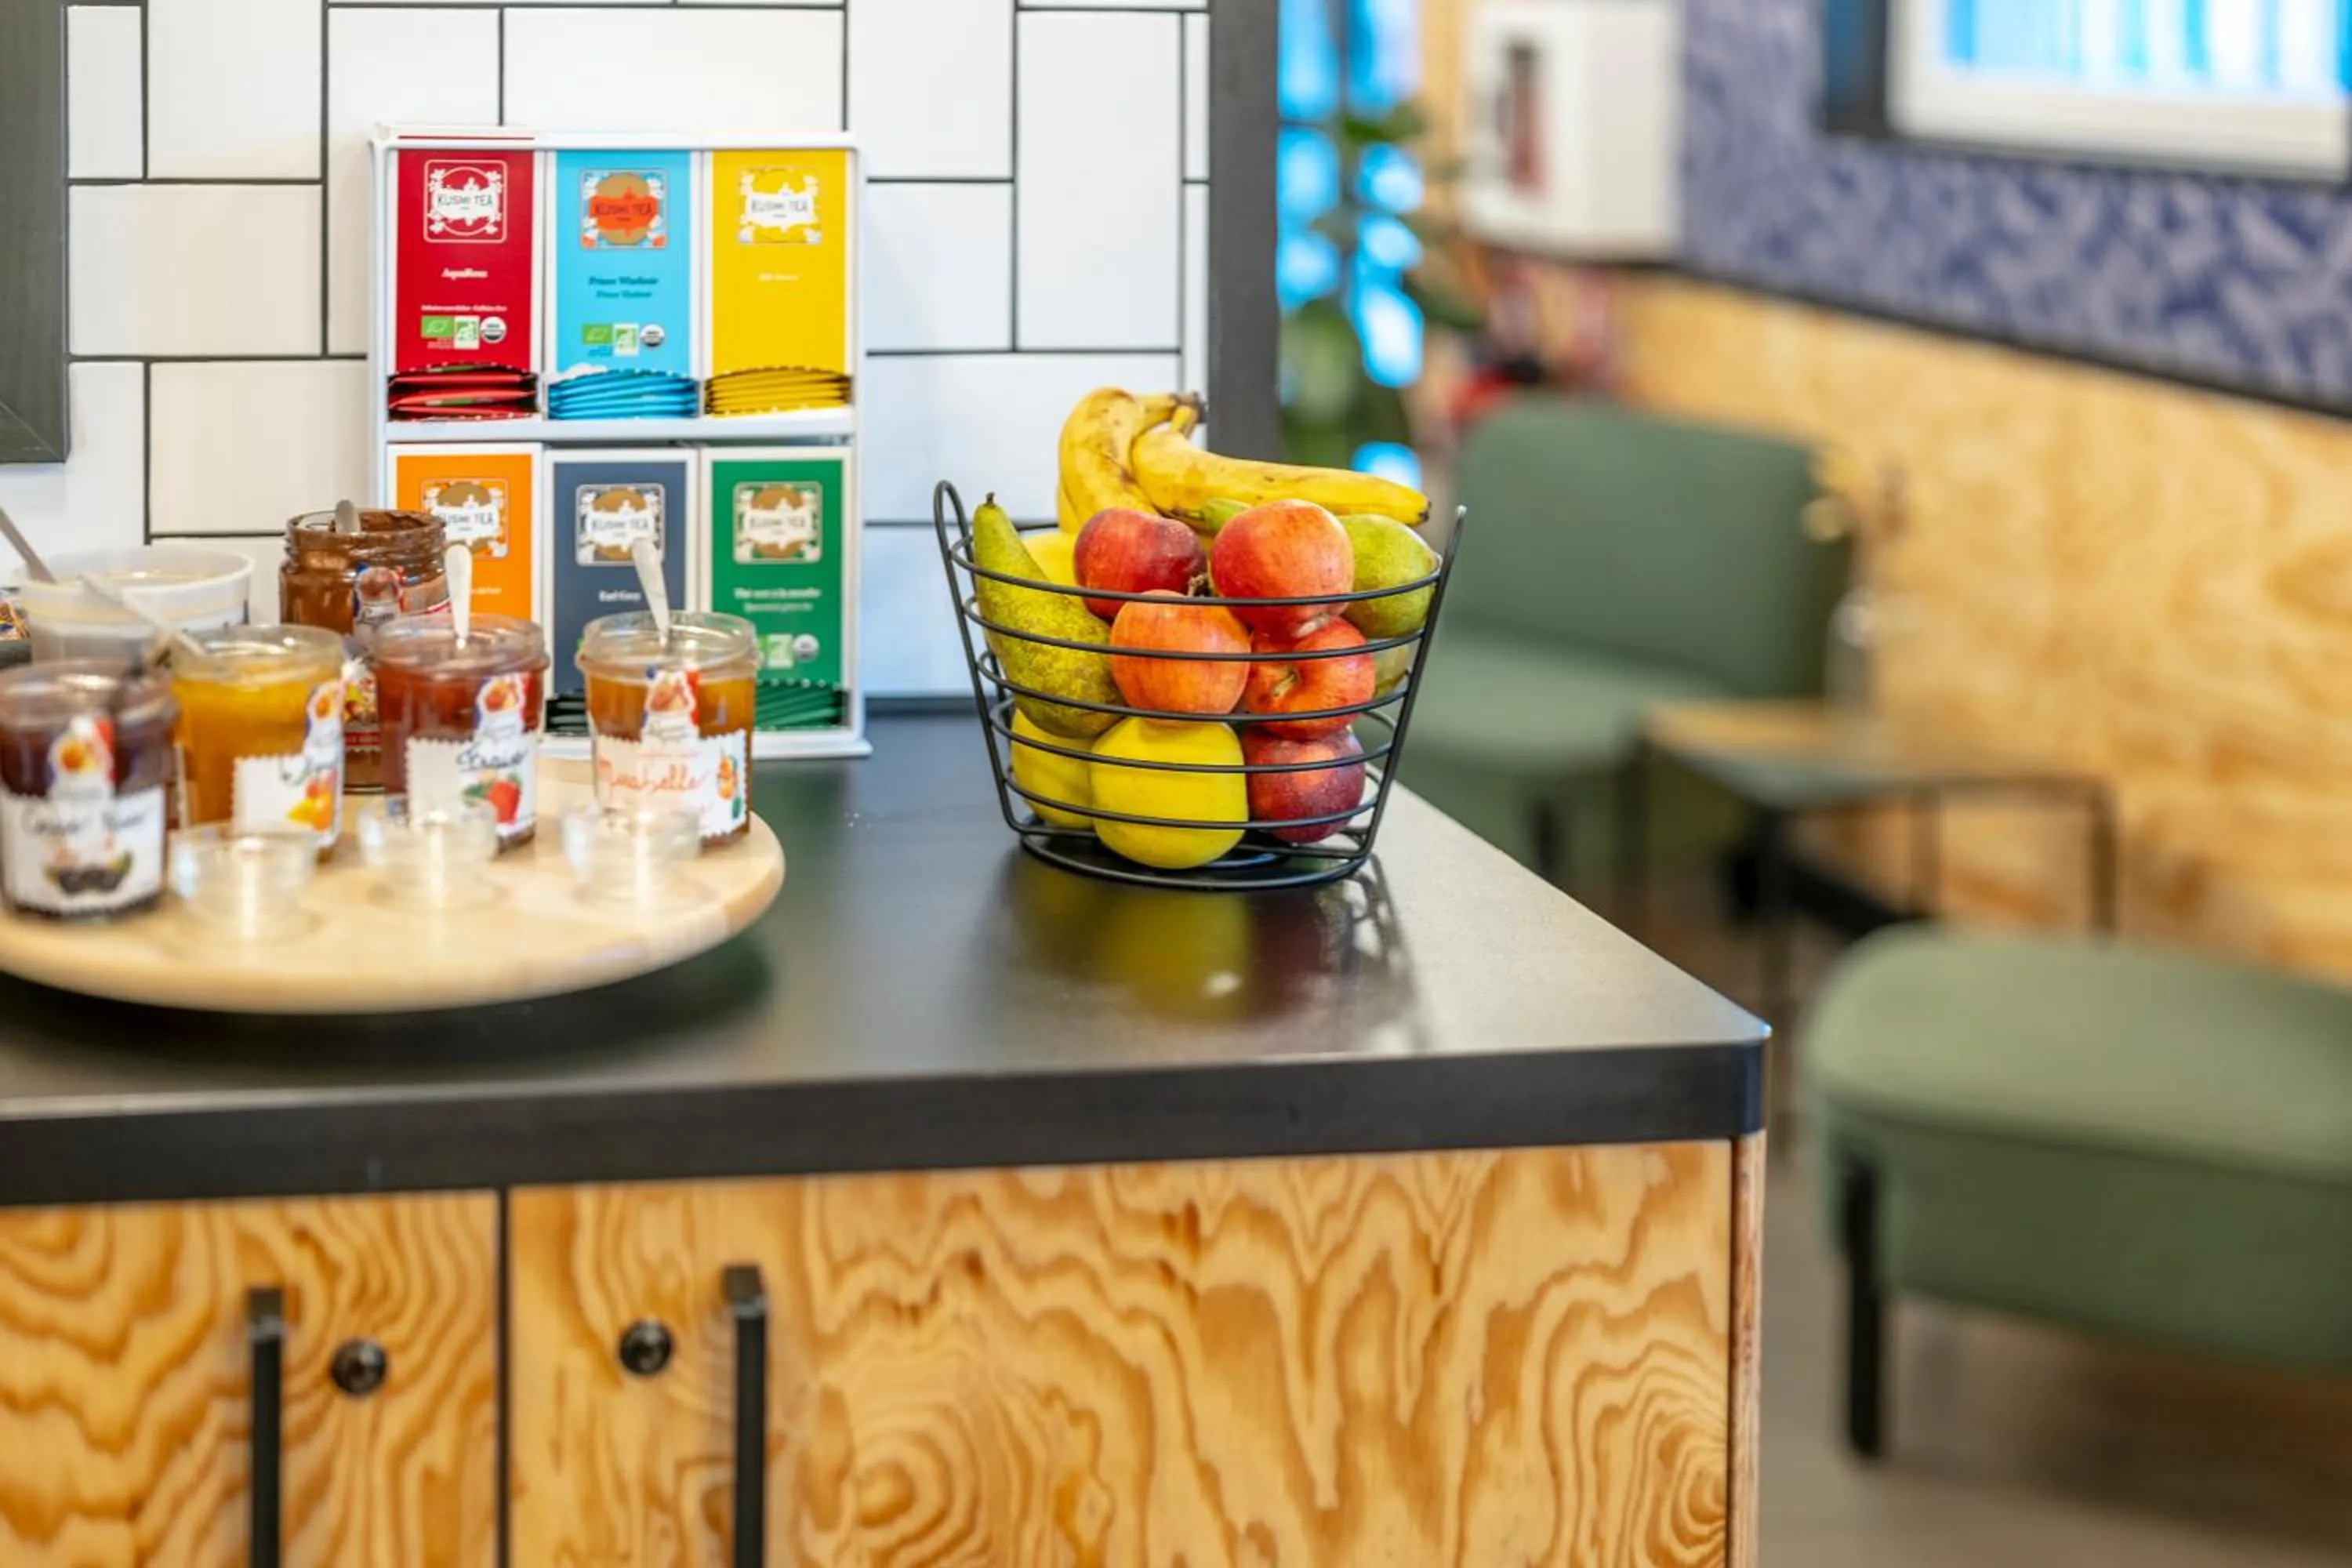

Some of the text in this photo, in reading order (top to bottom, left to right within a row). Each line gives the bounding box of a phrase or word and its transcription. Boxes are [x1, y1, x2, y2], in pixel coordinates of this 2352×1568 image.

[437, 194, 493, 207] KUSMI TEA
[788, 199, 809, 212] TEA
[632, 201, 652, 216] TEA
[474, 512, 493, 524] TEA
